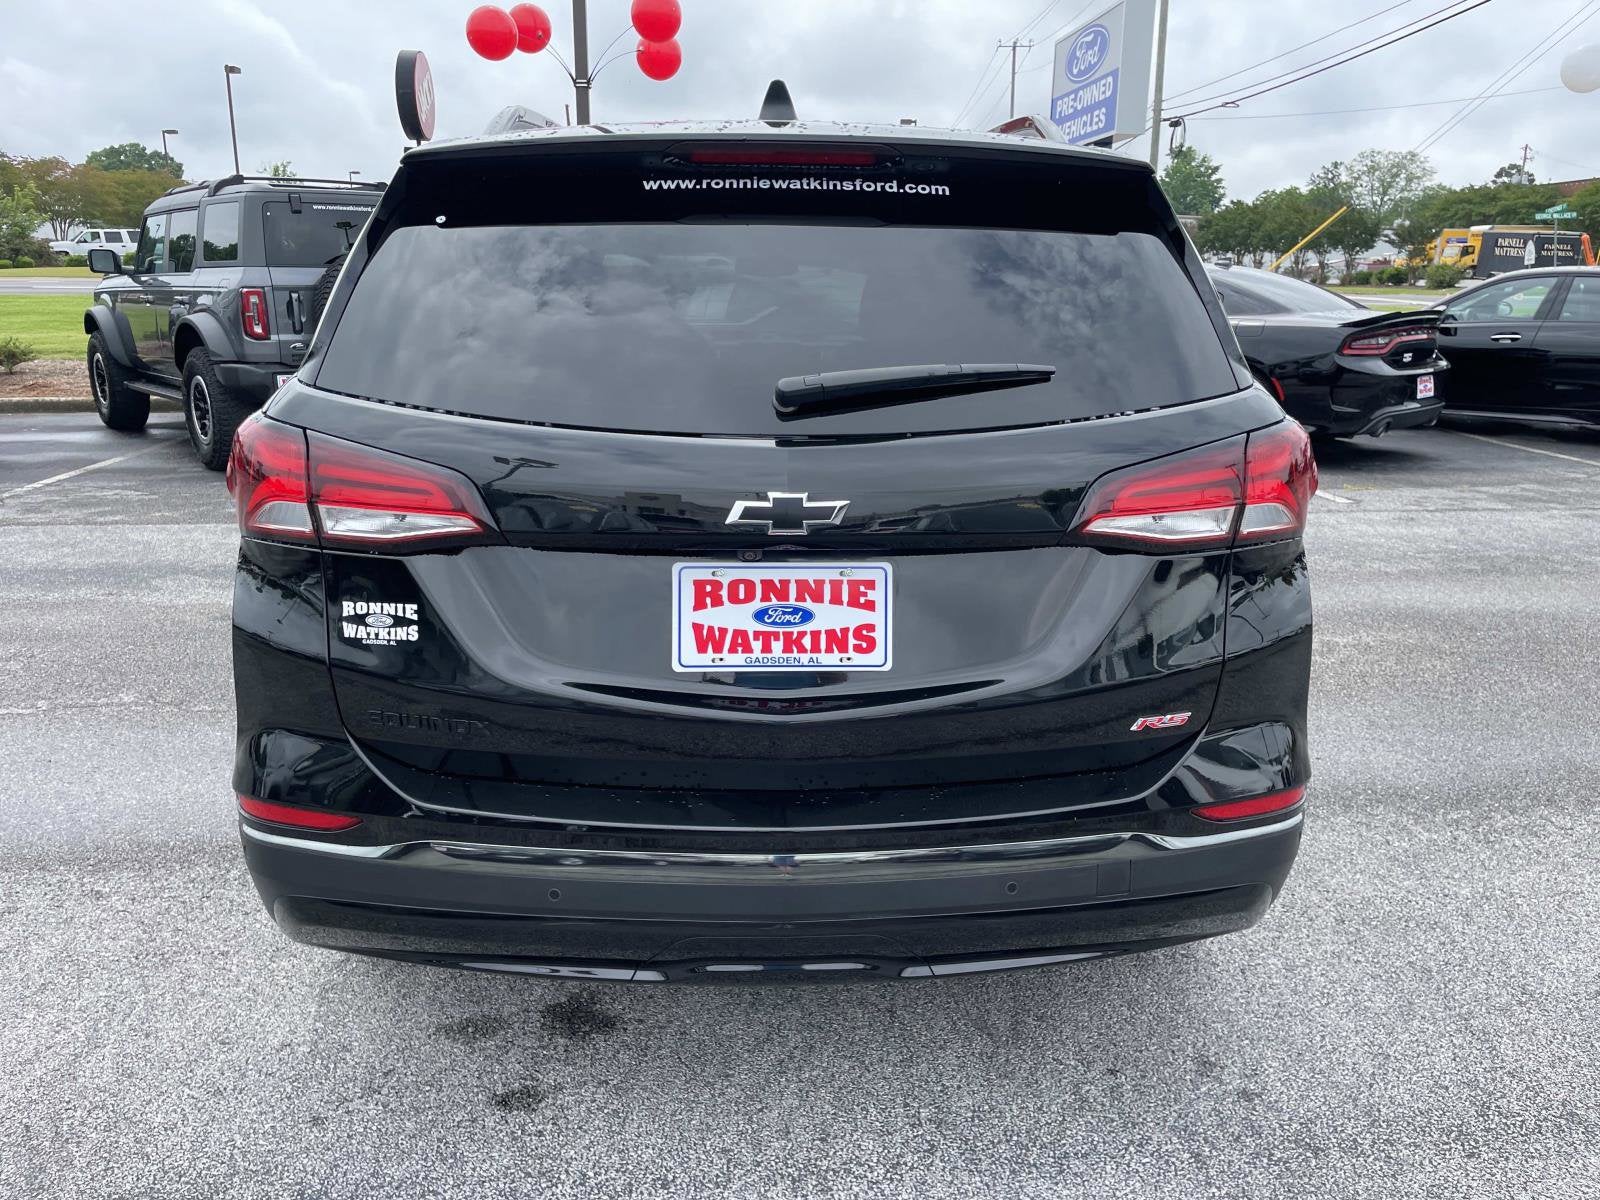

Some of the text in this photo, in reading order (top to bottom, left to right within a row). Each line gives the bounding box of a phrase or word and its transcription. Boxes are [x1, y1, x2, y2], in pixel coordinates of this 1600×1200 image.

[1072, 32, 1101, 75] Ford
[1055, 76, 1113, 119] PRE-OWNED
[643, 177, 950, 196] www.ronniewatkinsford.com
[313, 204, 376, 212] www.ronniewatkinsford.
[1494, 247, 1526, 257] MATTRESS
[1497, 237, 1525, 247] PARNELL
[692, 578, 876, 612] RONNIE
[341, 600, 419, 621] RONNIE
[763, 607, 802, 624] Ford
[342, 621, 419, 642] WATKINS
[691, 622, 877, 655] WATKINS
[744, 656, 823, 666] GADSDEN, AL
[1129, 711, 1192, 731] RS
